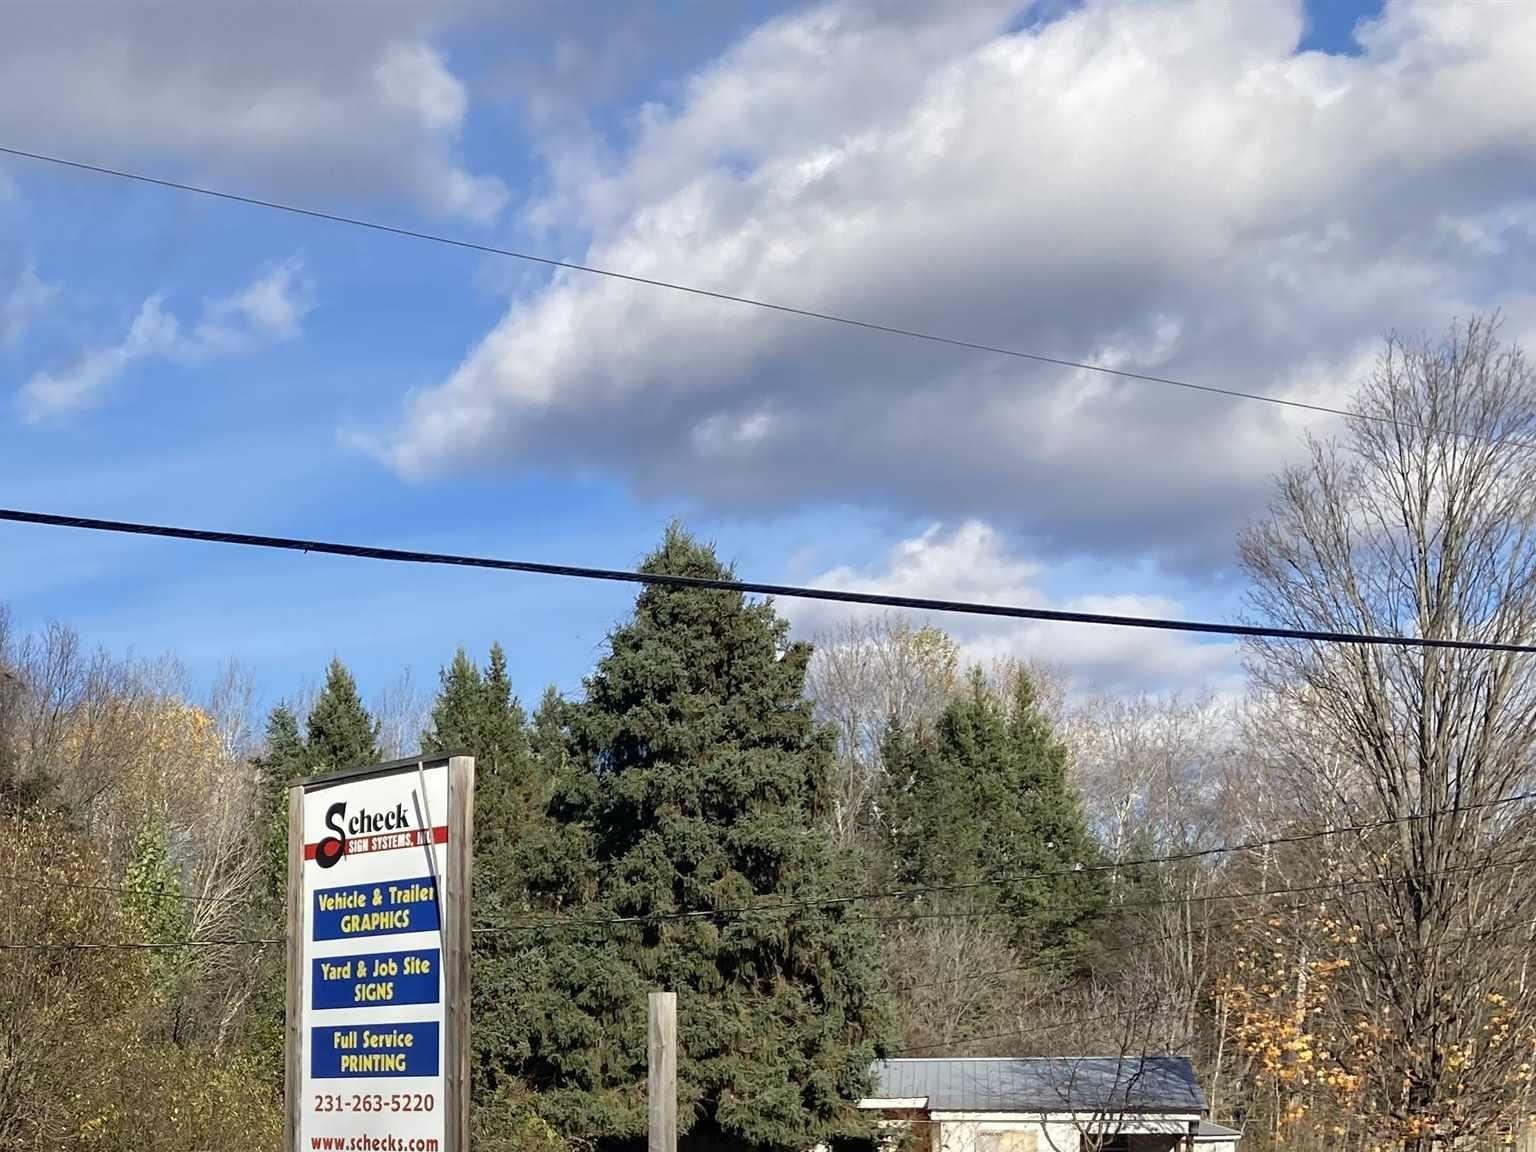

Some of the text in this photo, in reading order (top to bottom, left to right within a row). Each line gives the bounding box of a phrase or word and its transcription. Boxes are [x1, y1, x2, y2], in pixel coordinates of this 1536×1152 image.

[316, 802, 410, 869] Scheck
[348, 838, 369, 853] SIGN
[318, 883, 434, 911] Vehicle & Trailer
[340, 909, 410, 933] GRAPHICS
[320, 956, 430, 980] Yard & Job Site
[354, 982, 394, 1002] SIGNS
[333, 1030, 413, 1049] Full Service
[340, 1053, 407, 1072] PRINTING
[314, 1094, 434, 1112] 231-263-5220
[311, 1134, 439, 1152] www.schecks.com
